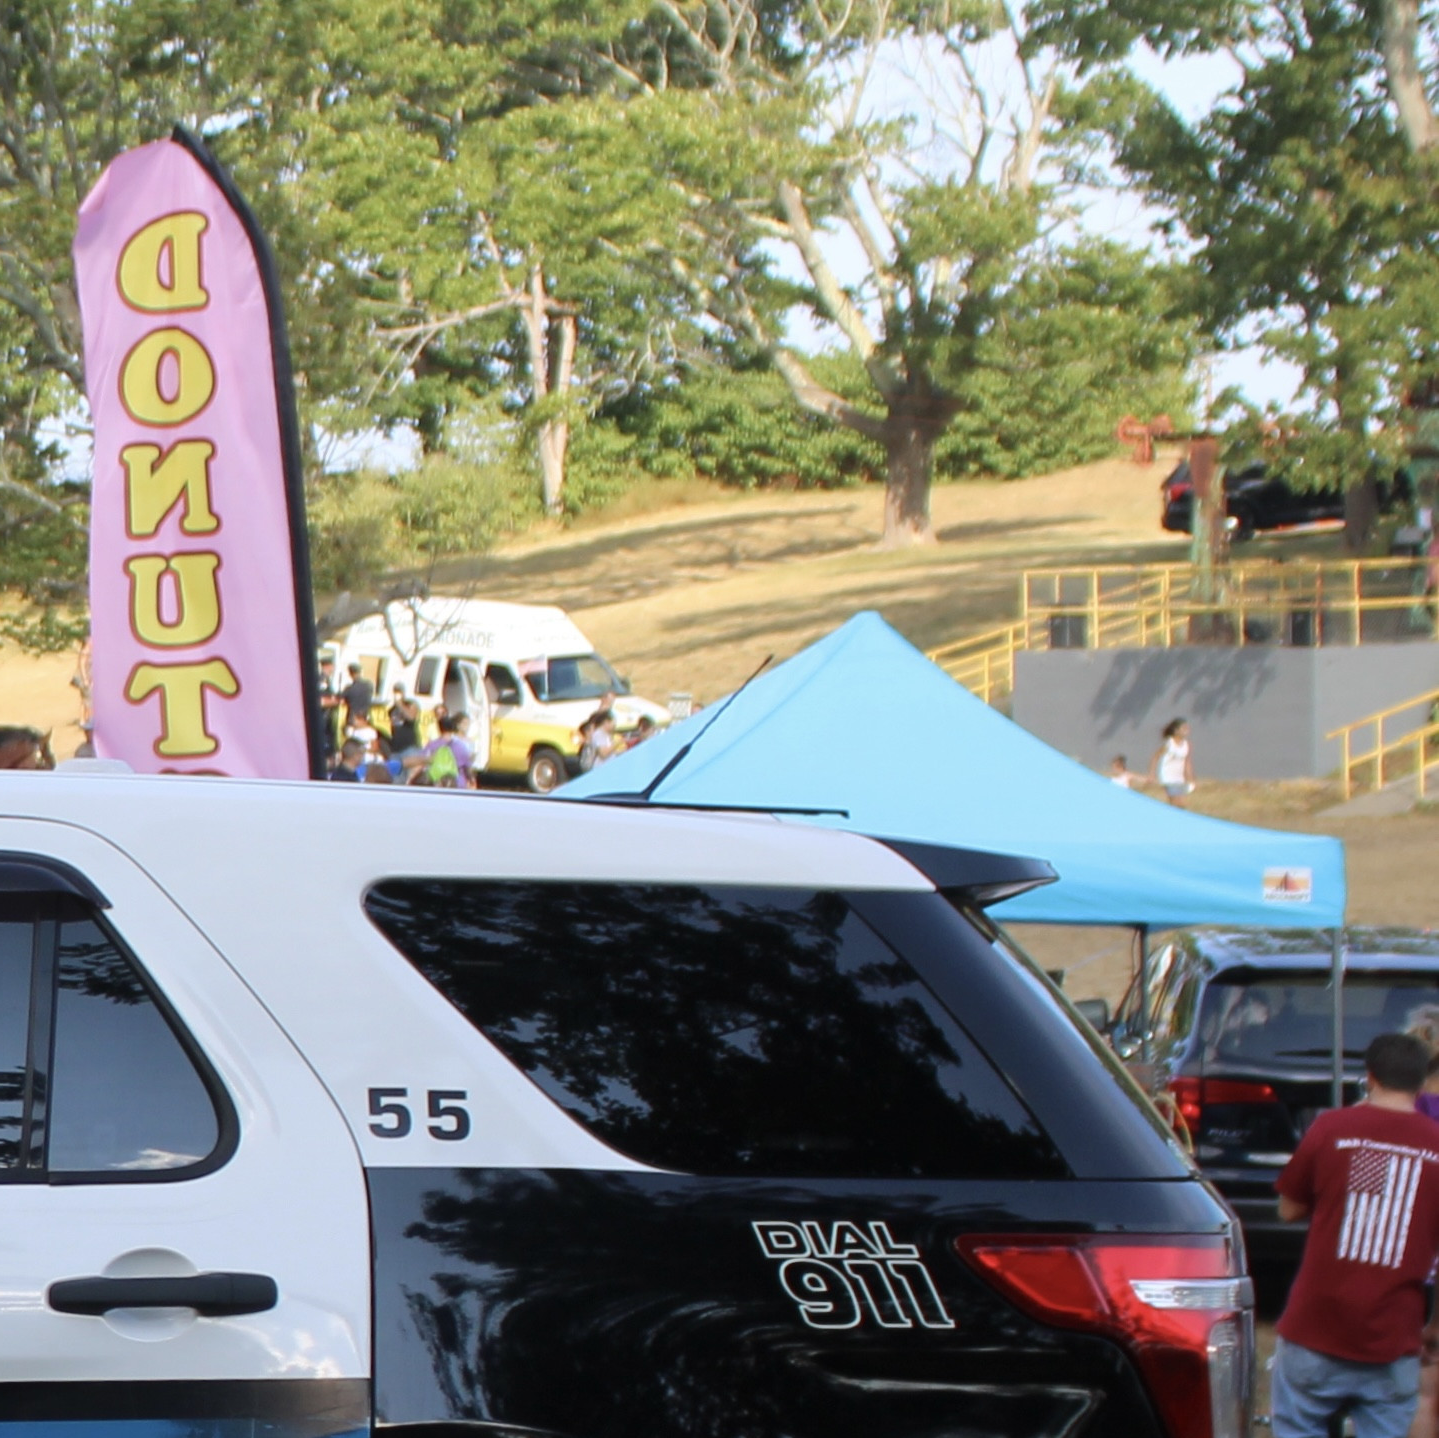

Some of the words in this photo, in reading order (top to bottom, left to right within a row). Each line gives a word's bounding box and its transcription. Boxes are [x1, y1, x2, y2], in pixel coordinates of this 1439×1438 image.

[414, 626, 495, 649] EMONADE
[367, 1086, 471, 1142] 55
[751, 1221, 920, 1259] DIAL
[779, 1257, 956, 1329] 911
